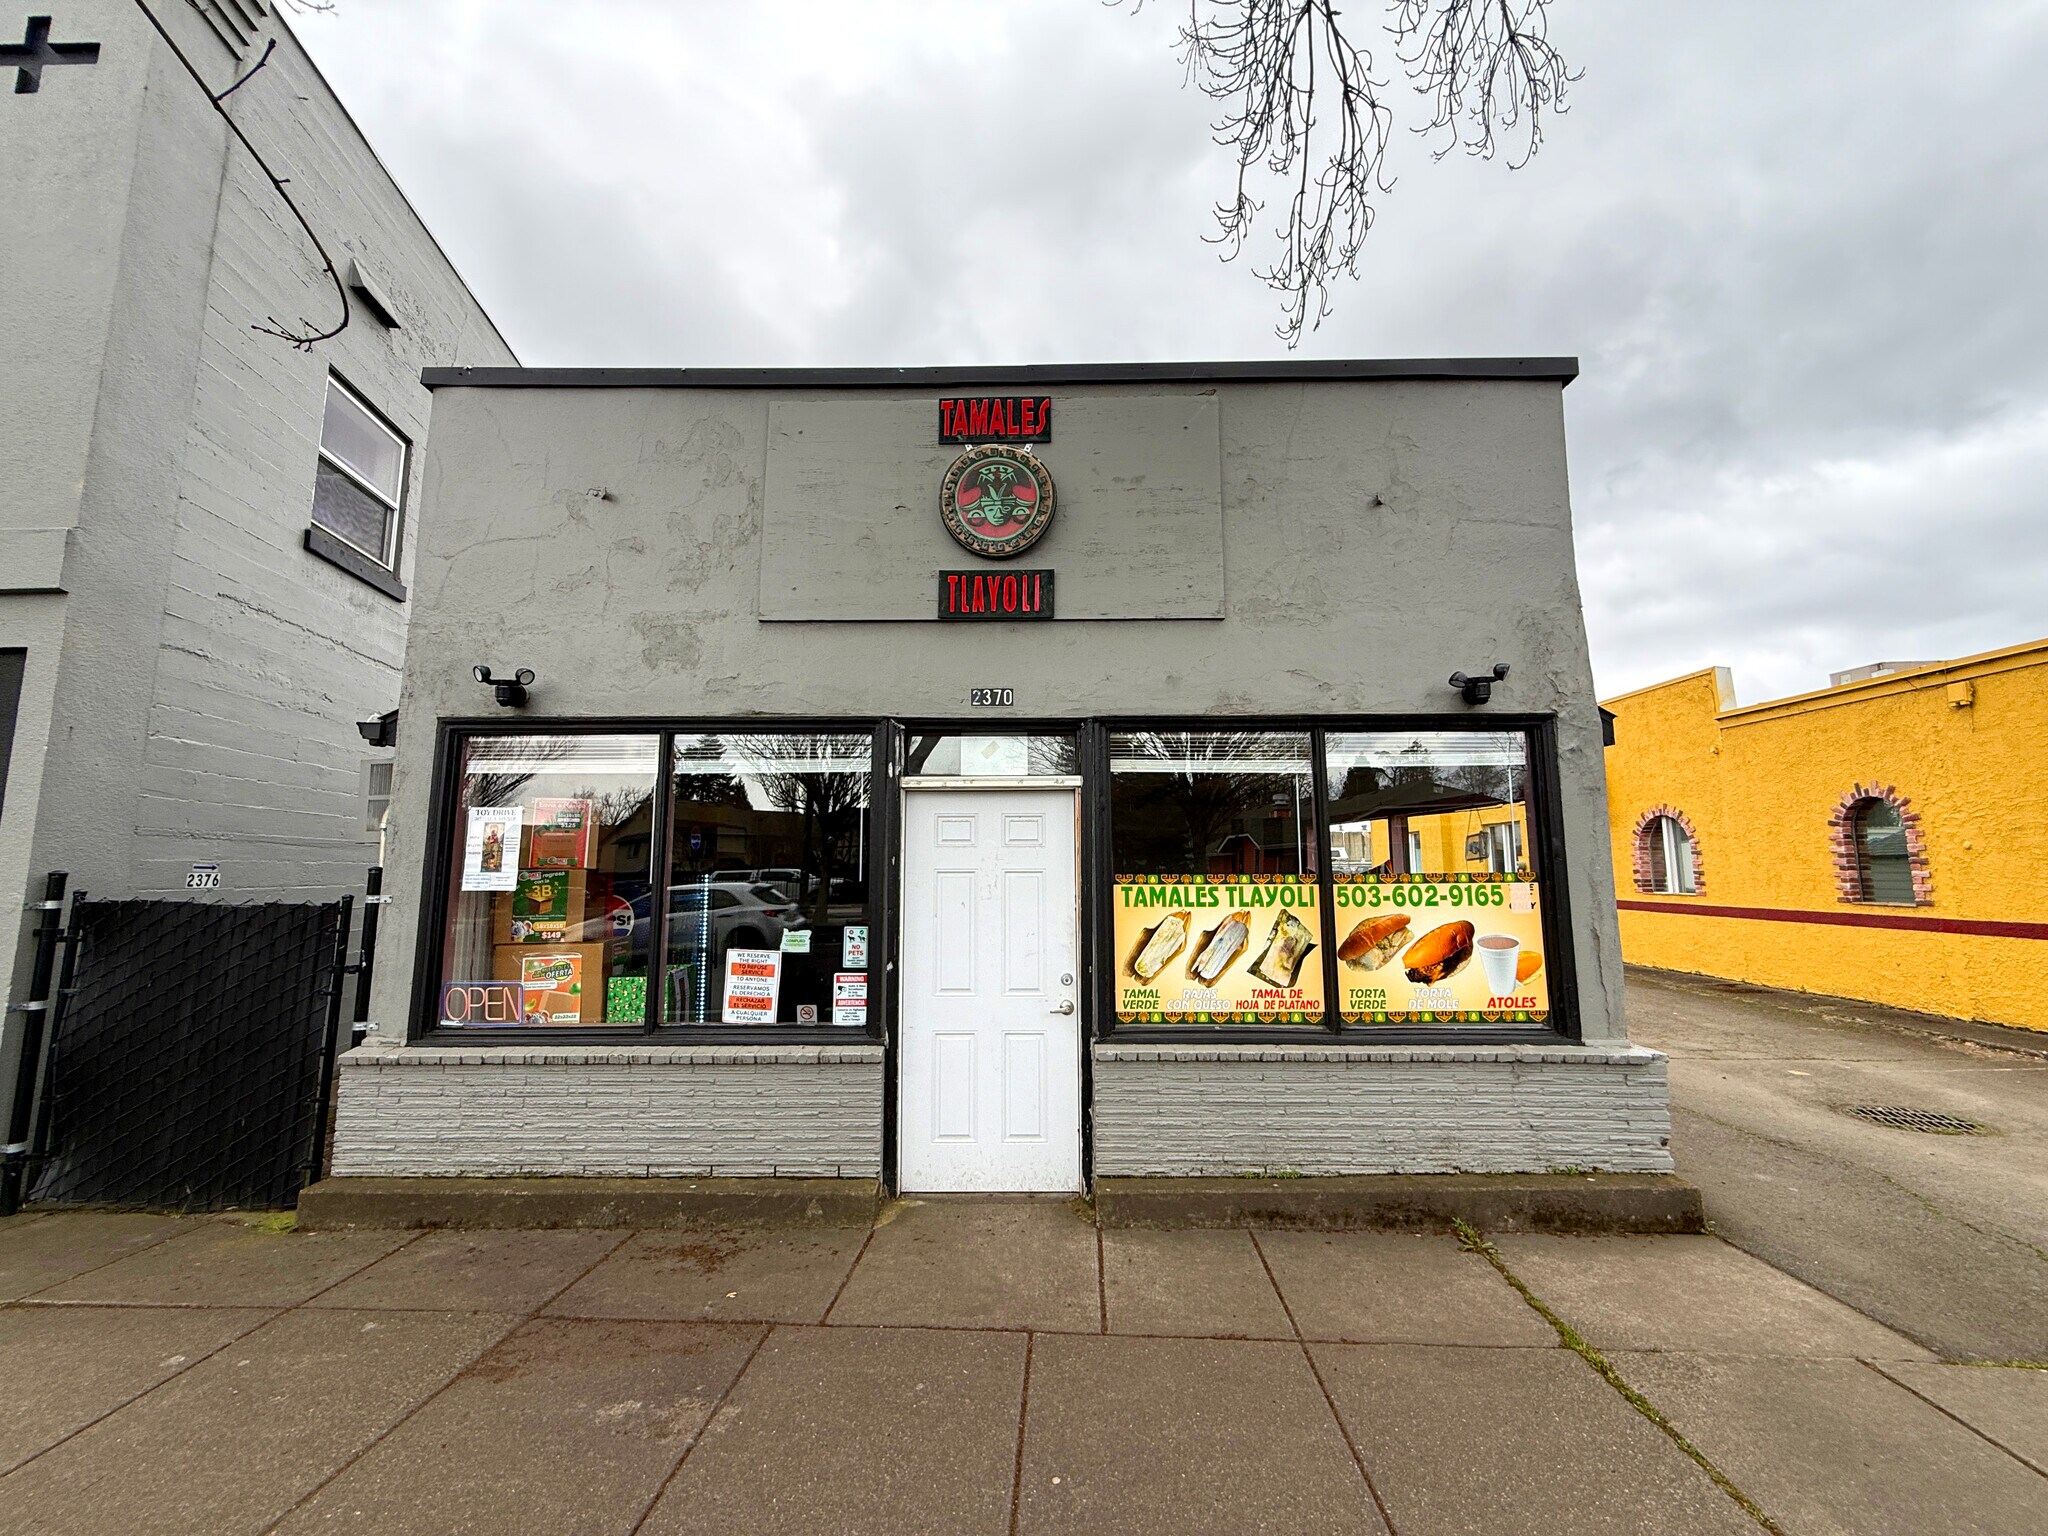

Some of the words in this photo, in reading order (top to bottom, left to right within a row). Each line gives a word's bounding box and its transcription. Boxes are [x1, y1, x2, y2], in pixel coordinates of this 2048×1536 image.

[941, 398, 1050, 436] TAMALES
[947, 574, 1041, 613] TLAYOLI
[972, 689, 1013, 706] 2370
[187, 874, 219, 887] 2376
[531, 884, 552, 897] 3B
[1336, 884, 1504, 908] 503-602-9165
[1121, 886, 1220, 908] TAMALES
[1225, 886, 1315, 908] TLAYOLI
[541, 931, 561, 939] $149
[545, 968, 573, 979] OFERTA
[1123, 989, 1161, 999] TAMAL
[1182, 988, 1218, 999] RAJAS
[1251, 989, 1288, 999] TAMAL
[1289, 989, 1303, 999] DE
[1349, 989, 1386, 999] TORTA
[1414, 987, 1453, 999] TORTA
[445, 986, 521, 1021] OPEN
[1122, 1000, 1160, 1010] VERDE
[1166, 1000, 1192, 1010] CON
[1193, 1000, 1231, 1011] QUESO
[1236, 1000, 1260, 1010] HOJA
[1264, 1000, 1276, 1010] DE
[1277, 1000, 1320, 1010] PLATANO
[1350, 1000, 1387, 1010] VERDE
[1408, 1000, 1424, 1010] DE
[1427, 1000, 1460, 1010] MOLE
[1487, 997, 1537, 1009] ATOLES
